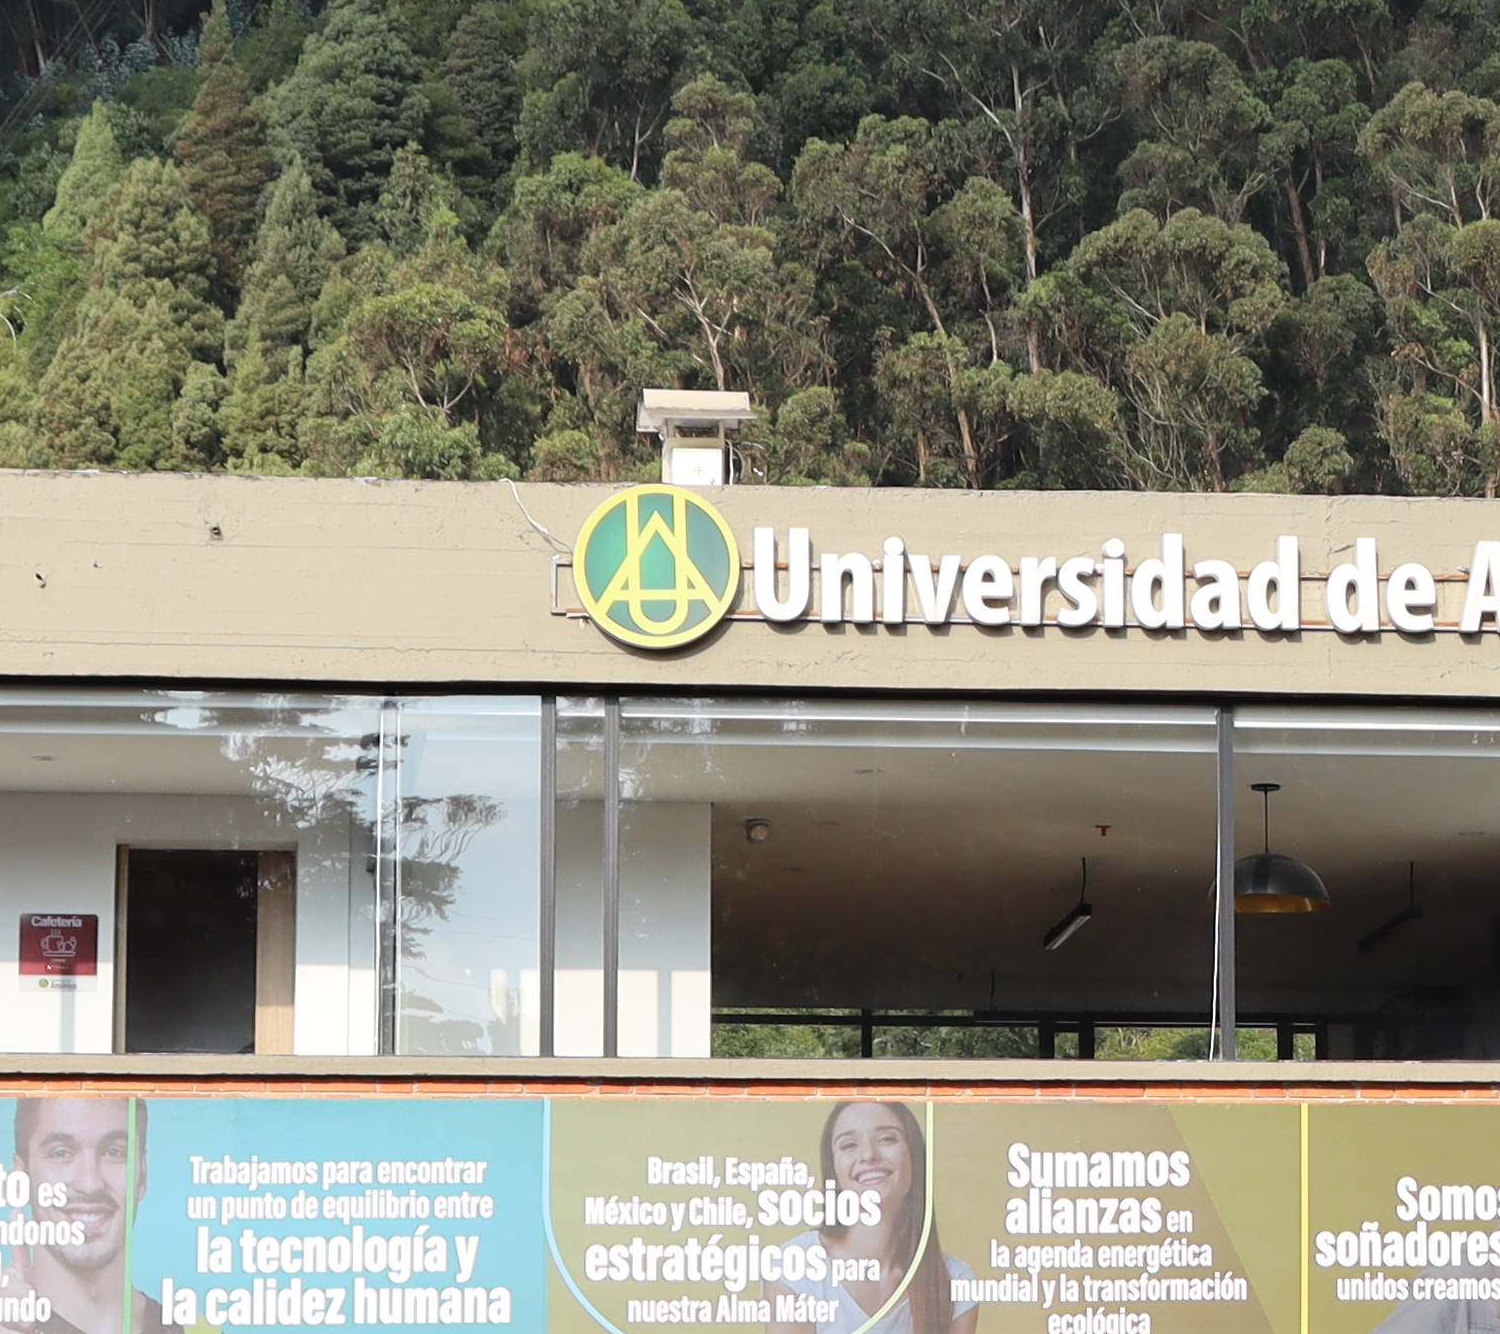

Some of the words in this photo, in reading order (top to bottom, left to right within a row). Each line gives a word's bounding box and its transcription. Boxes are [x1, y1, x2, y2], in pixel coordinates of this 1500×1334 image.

[752, 528, 1301, 629] Universidad
[1324, 537, 1436, 631] de
[190, 1155, 318, 1190] Trabajamos
[323, 1161, 372, 1190] para
[378, 1157, 487, 1183] encontrar
[648, 1156, 720, 1188] Brasil,
[726, 1157, 814, 1191] España,
[1008, 1143, 1190, 1187] Sumamos
[39, 1183, 66, 1207] es
[189, 1197, 215, 1218] un
[222, 1193, 287, 1225] punto
[291, 1190, 318, 1219] de
[323, 1189, 430, 1224] equilibrio
[434, 1192, 493, 1218] entre
[585, 1196, 666, 1225] México
[671, 1203, 685, 1231] y
[689, 1197, 753, 1228] Chile,
[758, 1180, 880, 1226] socios
[1006, 1188, 1162, 1234] alianzas
[1167, 1211, 1192, 1232] en
[198, 1226, 231, 1273] la
[240, 1225, 447, 1283] tecnología
[455, 1236, 479, 1282] y
[586, 1234, 827, 1292] estratégicos
[832, 1259, 880, 1287] para
[991, 1239, 1009, 1267] la
[1015, 1240, 1093, 1274] agenda
[1098, 1238, 1212, 1273] energética
[163, 1278, 196, 1325] la
[206, 1278, 345, 1325] calidez
[355, 1277, 510, 1324] humana
[951, 1274, 1037, 1301] mundial
[1042, 1280, 1056, 1308] y
[1060, 1274, 1078, 1302] la
[1083, 1272, 1247, 1302] transformación
[1337, 1272, 1408, 1300] unidos
[628, 1296, 711, 1322] nuestra
[716, 1294, 770, 1322] Alma
[776, 1293, 839, 1322] Máter
